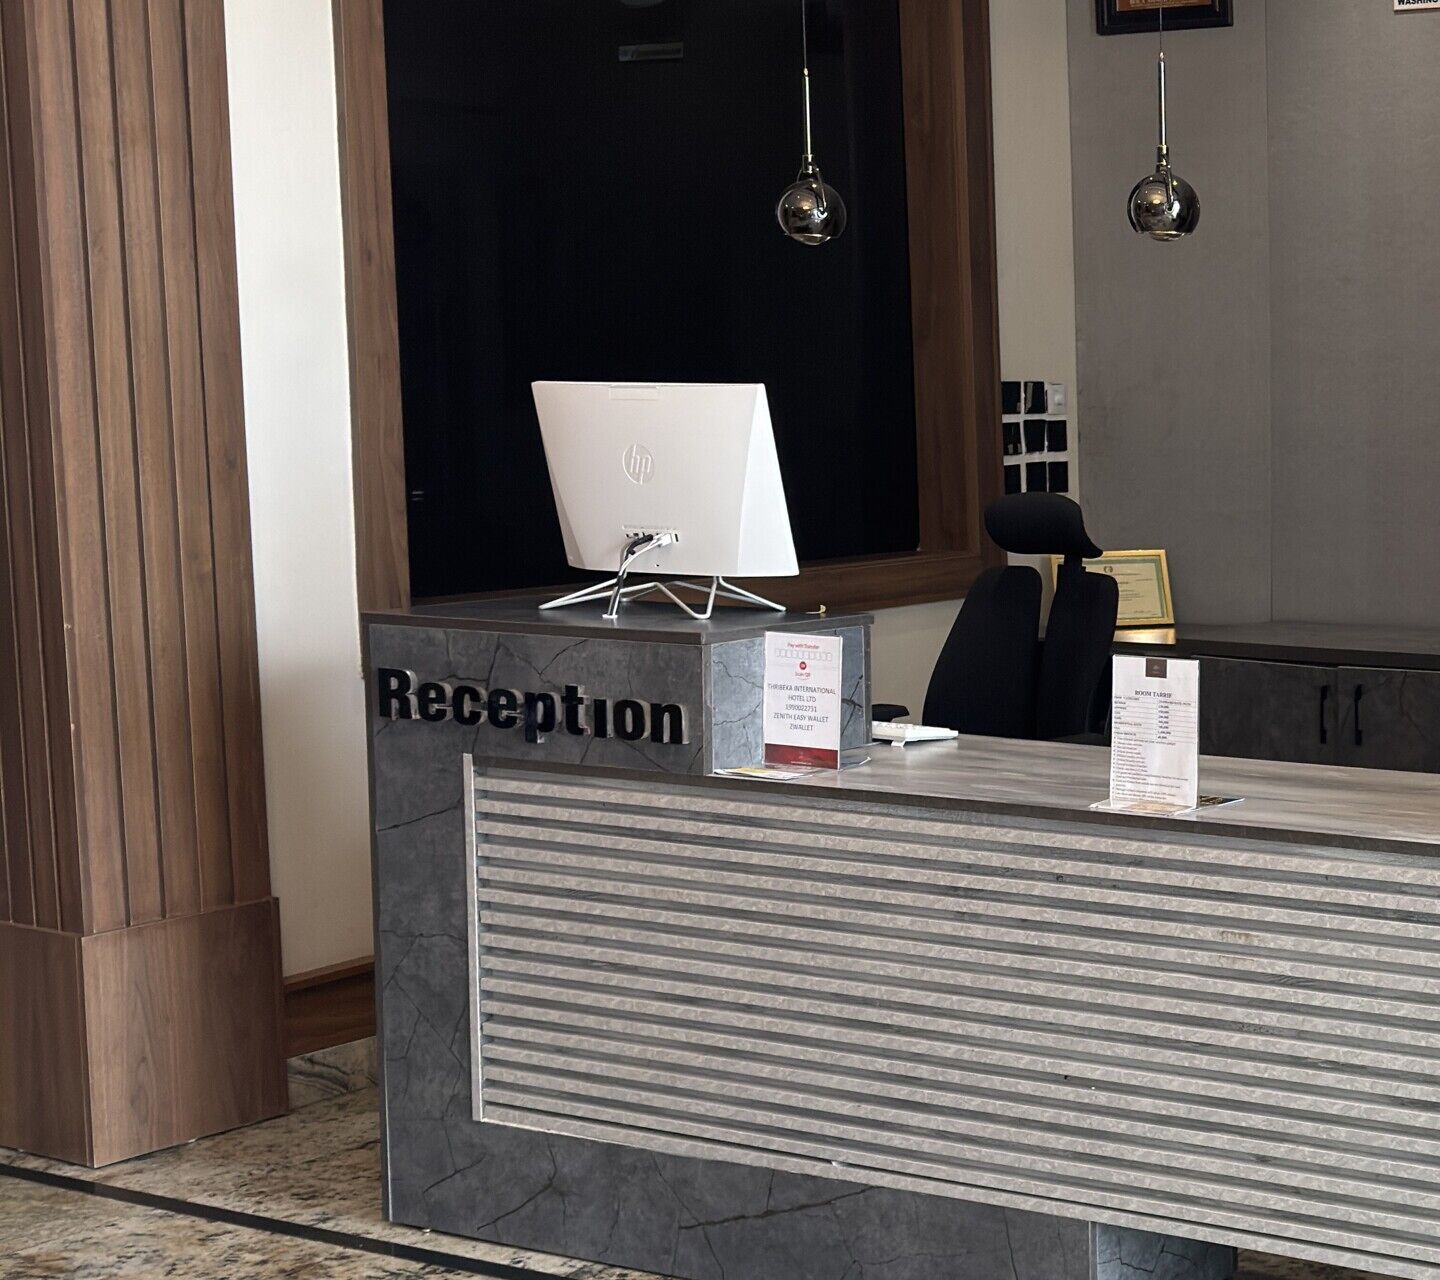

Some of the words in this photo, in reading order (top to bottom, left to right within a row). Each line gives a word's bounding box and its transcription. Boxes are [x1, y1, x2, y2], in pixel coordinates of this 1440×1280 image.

[627, 442, 653, 486] hp
[794, 685, 836, 695] INTERNATIONAL
[788, 694, 805, 702] HOTEL
[806, 695, 817, 703] LTD
[377, 667, 690, 744] Reception
[773, 712, 792, 720] ZENITH
[793, 713, 807, 721] EASY
[808, 715, 829, 723] WALLET
[789, 723, 814, 731] ZWALLET
